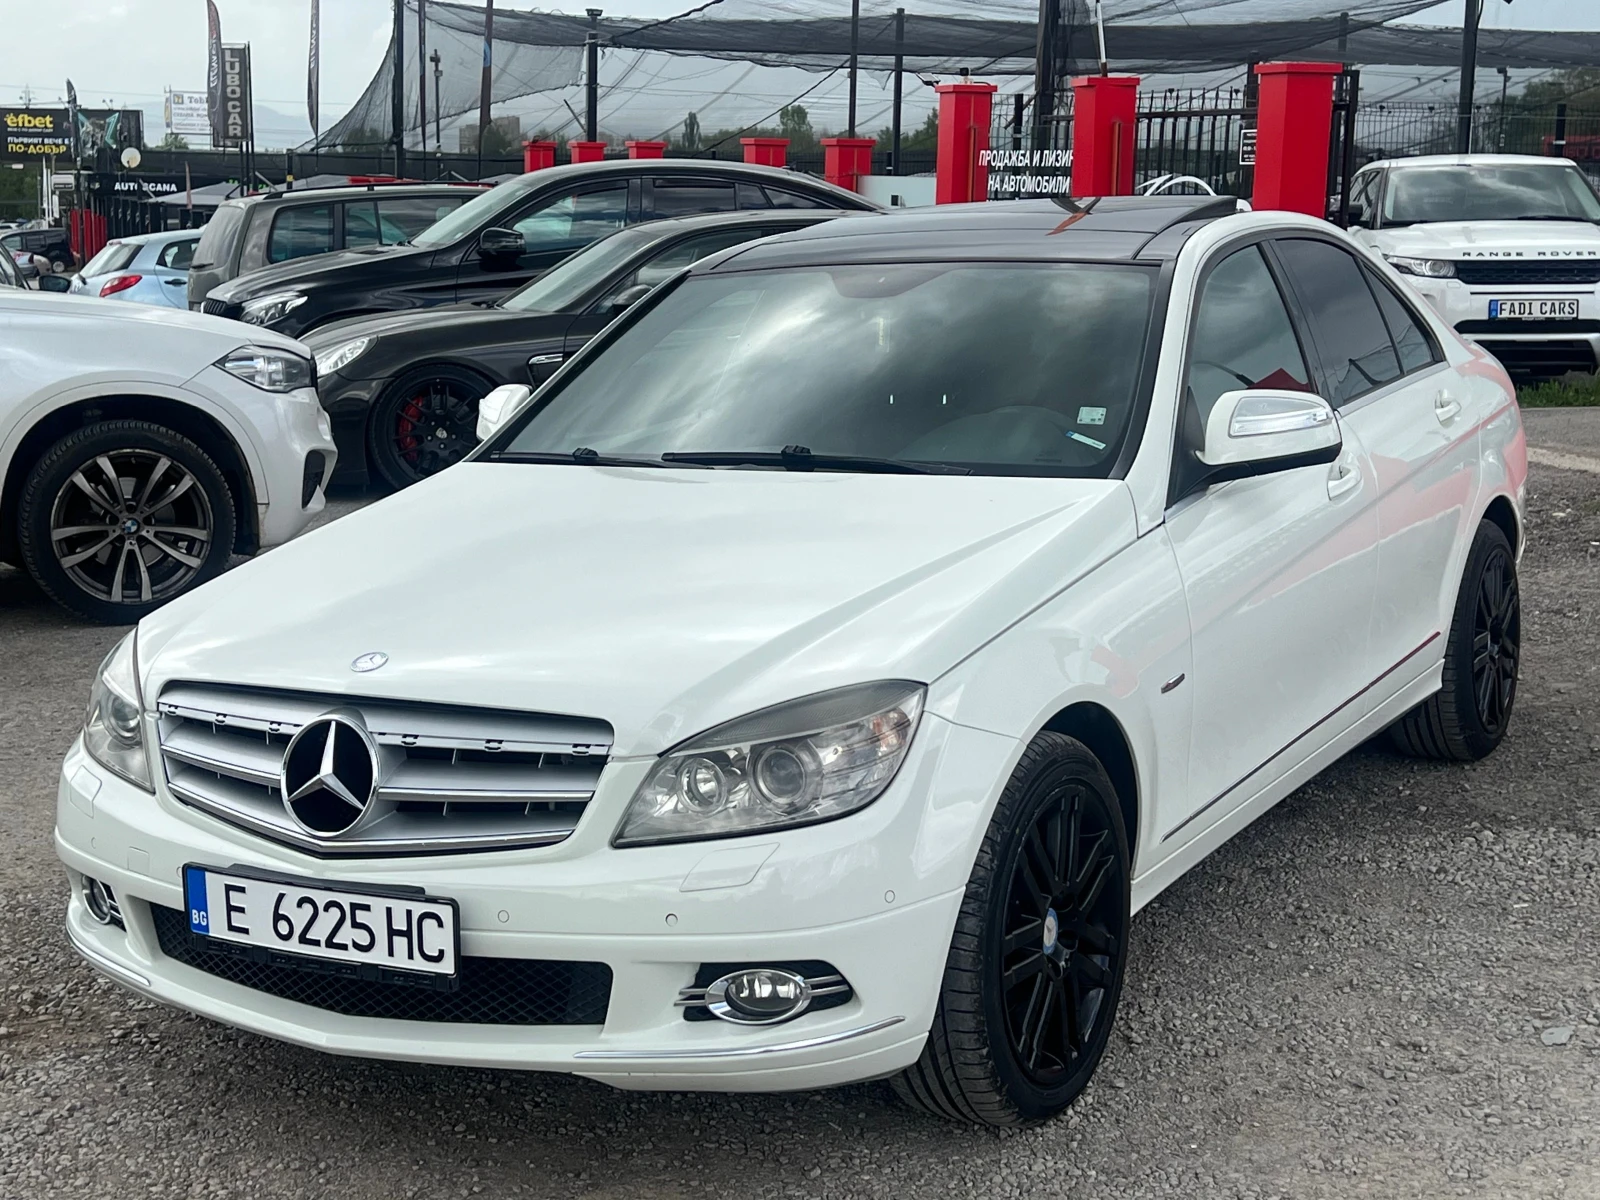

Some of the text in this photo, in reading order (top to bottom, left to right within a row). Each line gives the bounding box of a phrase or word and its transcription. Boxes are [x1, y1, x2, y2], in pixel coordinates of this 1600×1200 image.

[225, 50, 243, 138] LUBO CAR
[5, 113, 54, 128] efbet
[8, 144, 67, 154] ПО-ДОБЪР
[978, 150, 1030, 170] ПРОДАЖБА
[1032, 150, 1041, 167] И
[987, 175, 1071, 194] НА АВТОМОБИЛИ
[1499, 301, 1576, 316] FADI CARS
[192, 909, 207, 926] BG
[224, 882, 445, 964] E 6225 HC
